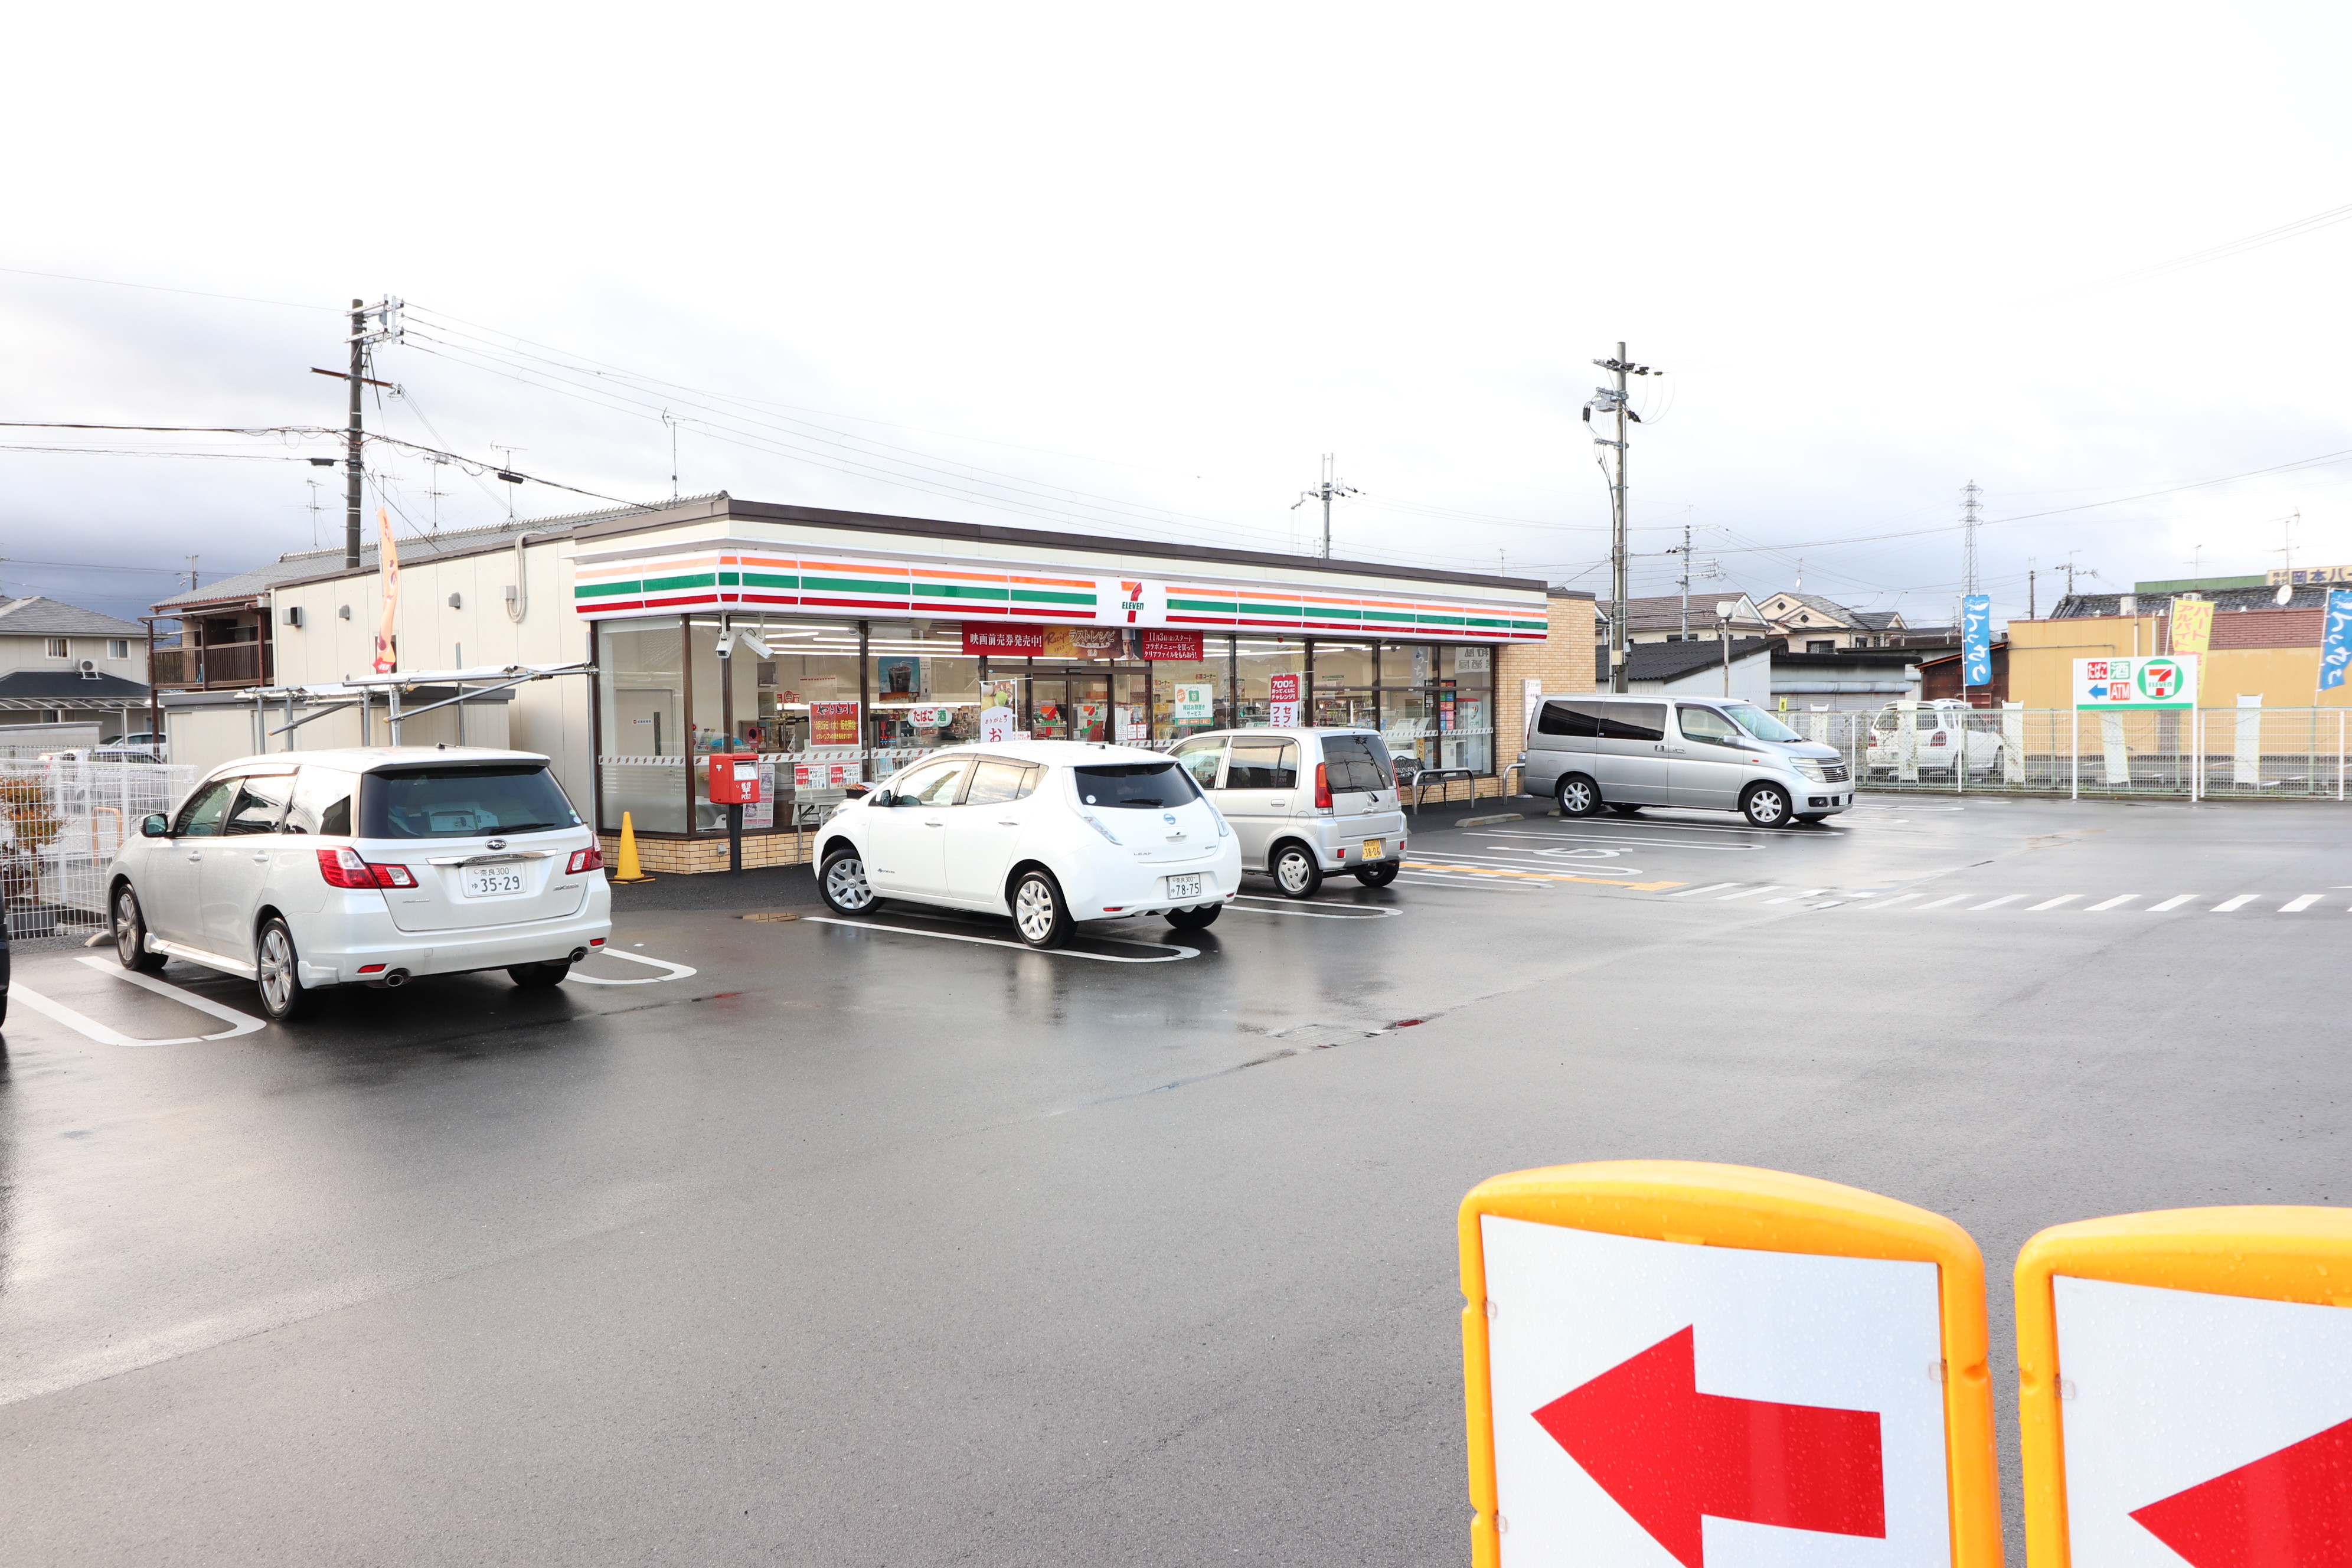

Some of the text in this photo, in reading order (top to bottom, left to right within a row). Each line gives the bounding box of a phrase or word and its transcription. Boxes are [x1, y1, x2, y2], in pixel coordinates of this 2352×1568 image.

[1122, 602, 1144, 610] ELEVEN
[2175, 605, 2194, 648] アルバイト
[2192, 606, 2211, 641] パート
[1069, 629, 1116, 643] ラストレシピ
[2088, 662, 2129, 679] たばこ 酒
[1272, 680, 1293, 688] 700円
[2111, 683, 2130, 700] ATM
[913, 710, 946, 722] たばこ 酒
[1283, 705, 1292, 727] セブ
[989, 728, 1002, 742] お
[480, 876, 520, 893] 35-29
[1175, 883, 1200, 896] 78-75
